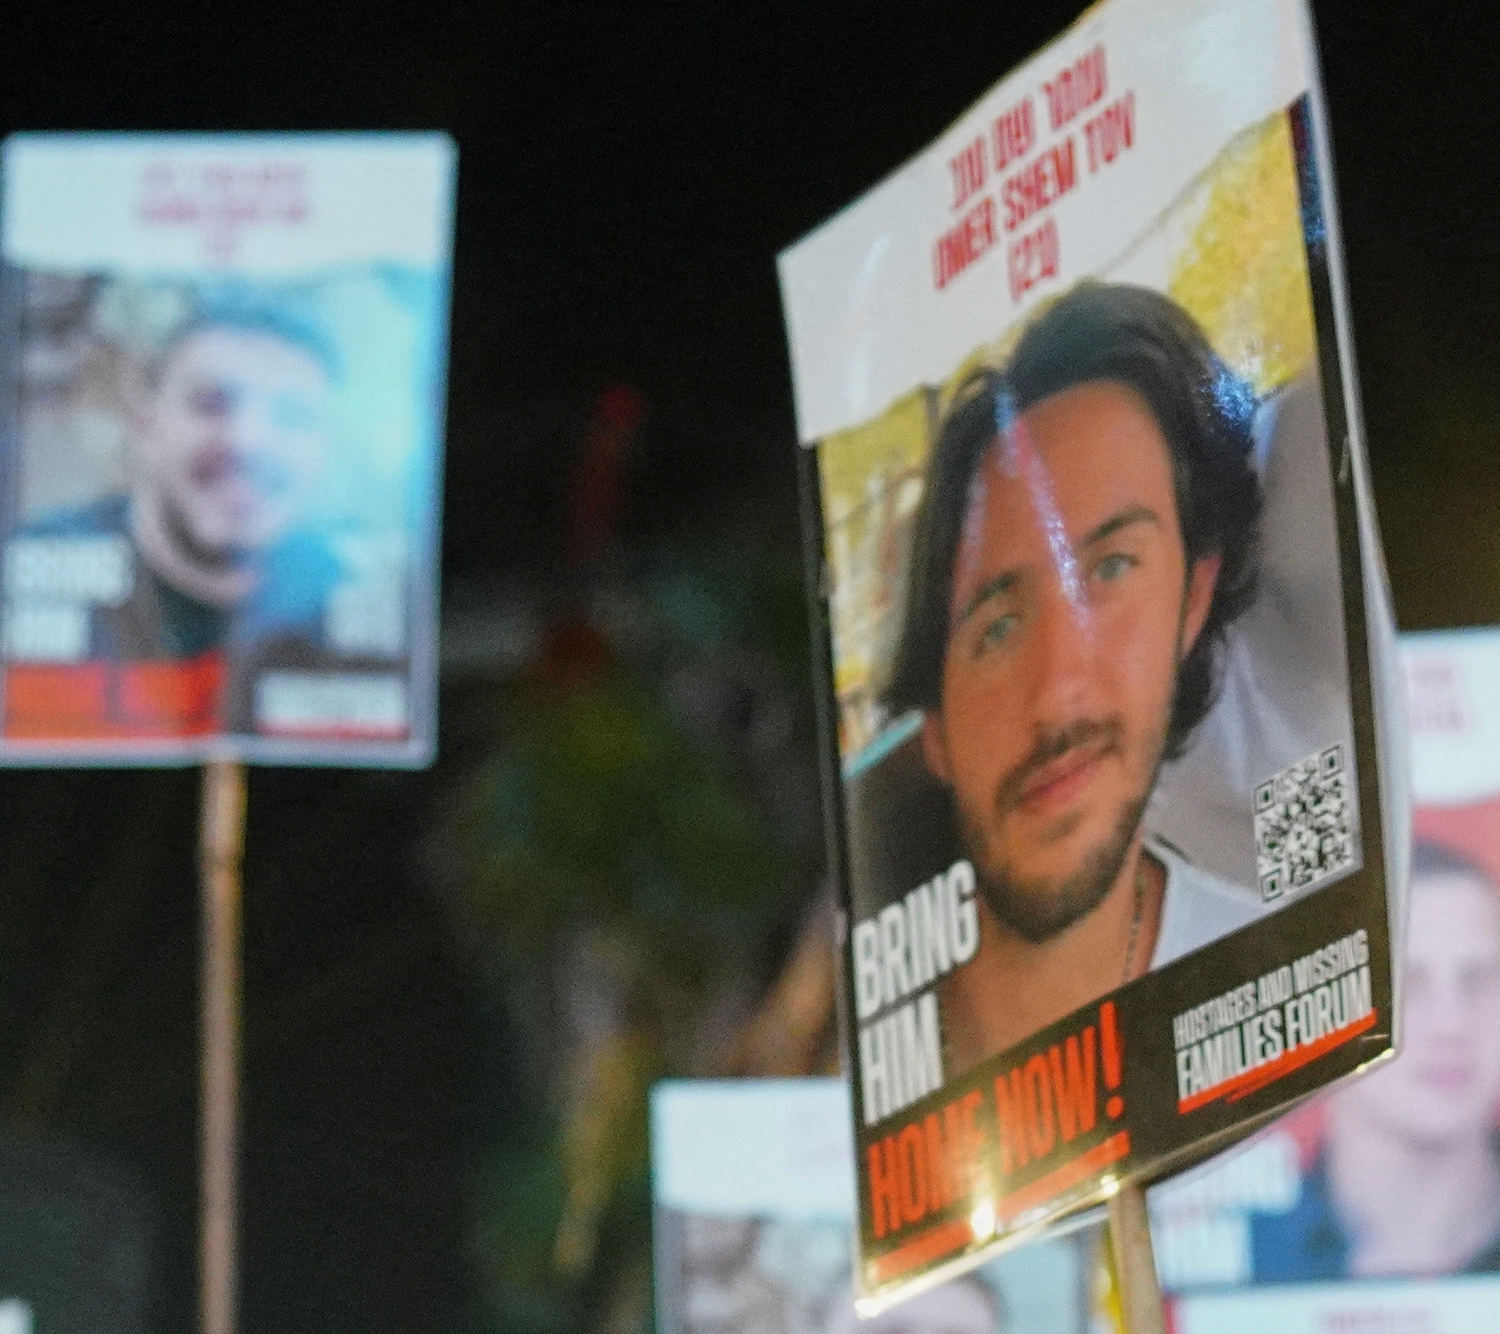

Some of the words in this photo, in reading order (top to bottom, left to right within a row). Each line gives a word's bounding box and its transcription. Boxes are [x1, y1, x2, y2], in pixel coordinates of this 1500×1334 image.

[991, 95, 1036, 170] שם
[1043, 42, 1107, 130] עומר
[932, 197, 996, 289] OMER
[1003, 134, 1077, 231] SHEM
[1083, 87, 1136, 174] TOV
[949, 134, 988, 209] טוב
[1008, 214, 1061, 303] (21)
[851, 859, 980, 1019] BRING
[1173, 980, 1258, 1050] HOSTAGES
[1257, 965, 1294, 1009] AND
[1292, 928, 1370, 994] MISSING
[858, 989, 944, 1127] HIM
[1176, 1008, 1285, 1101] FAMILIES
[1285, 965, 1373, 1052] FORUM
[867, 1089, 986, 1241] HOME
[994, 1000, 1126, 1174] NOW!
